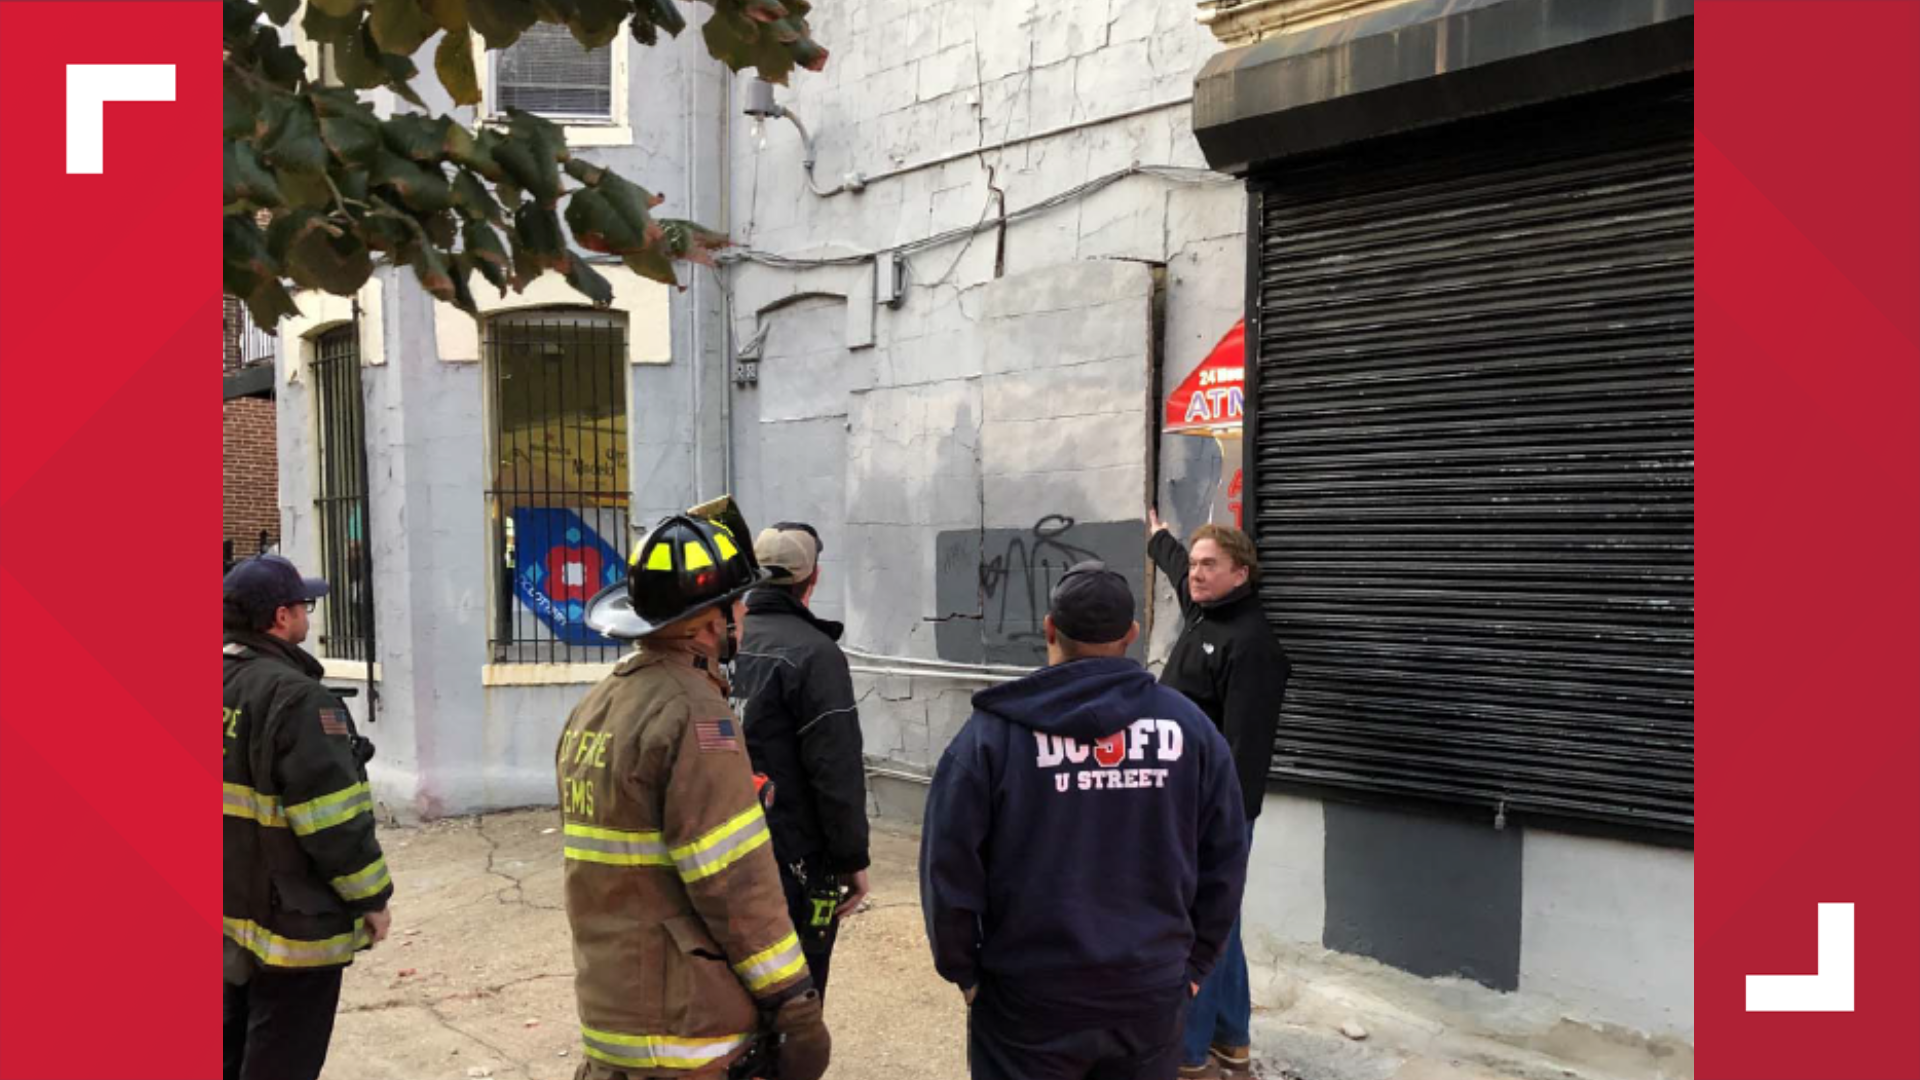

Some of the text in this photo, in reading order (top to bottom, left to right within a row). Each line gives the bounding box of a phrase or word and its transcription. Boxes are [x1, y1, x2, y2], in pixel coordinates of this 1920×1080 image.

[1199, 370, 1216, 386] 24
[1055, 768, 1169, 792] U STREET
[564, 778, 594, 817] EMS
